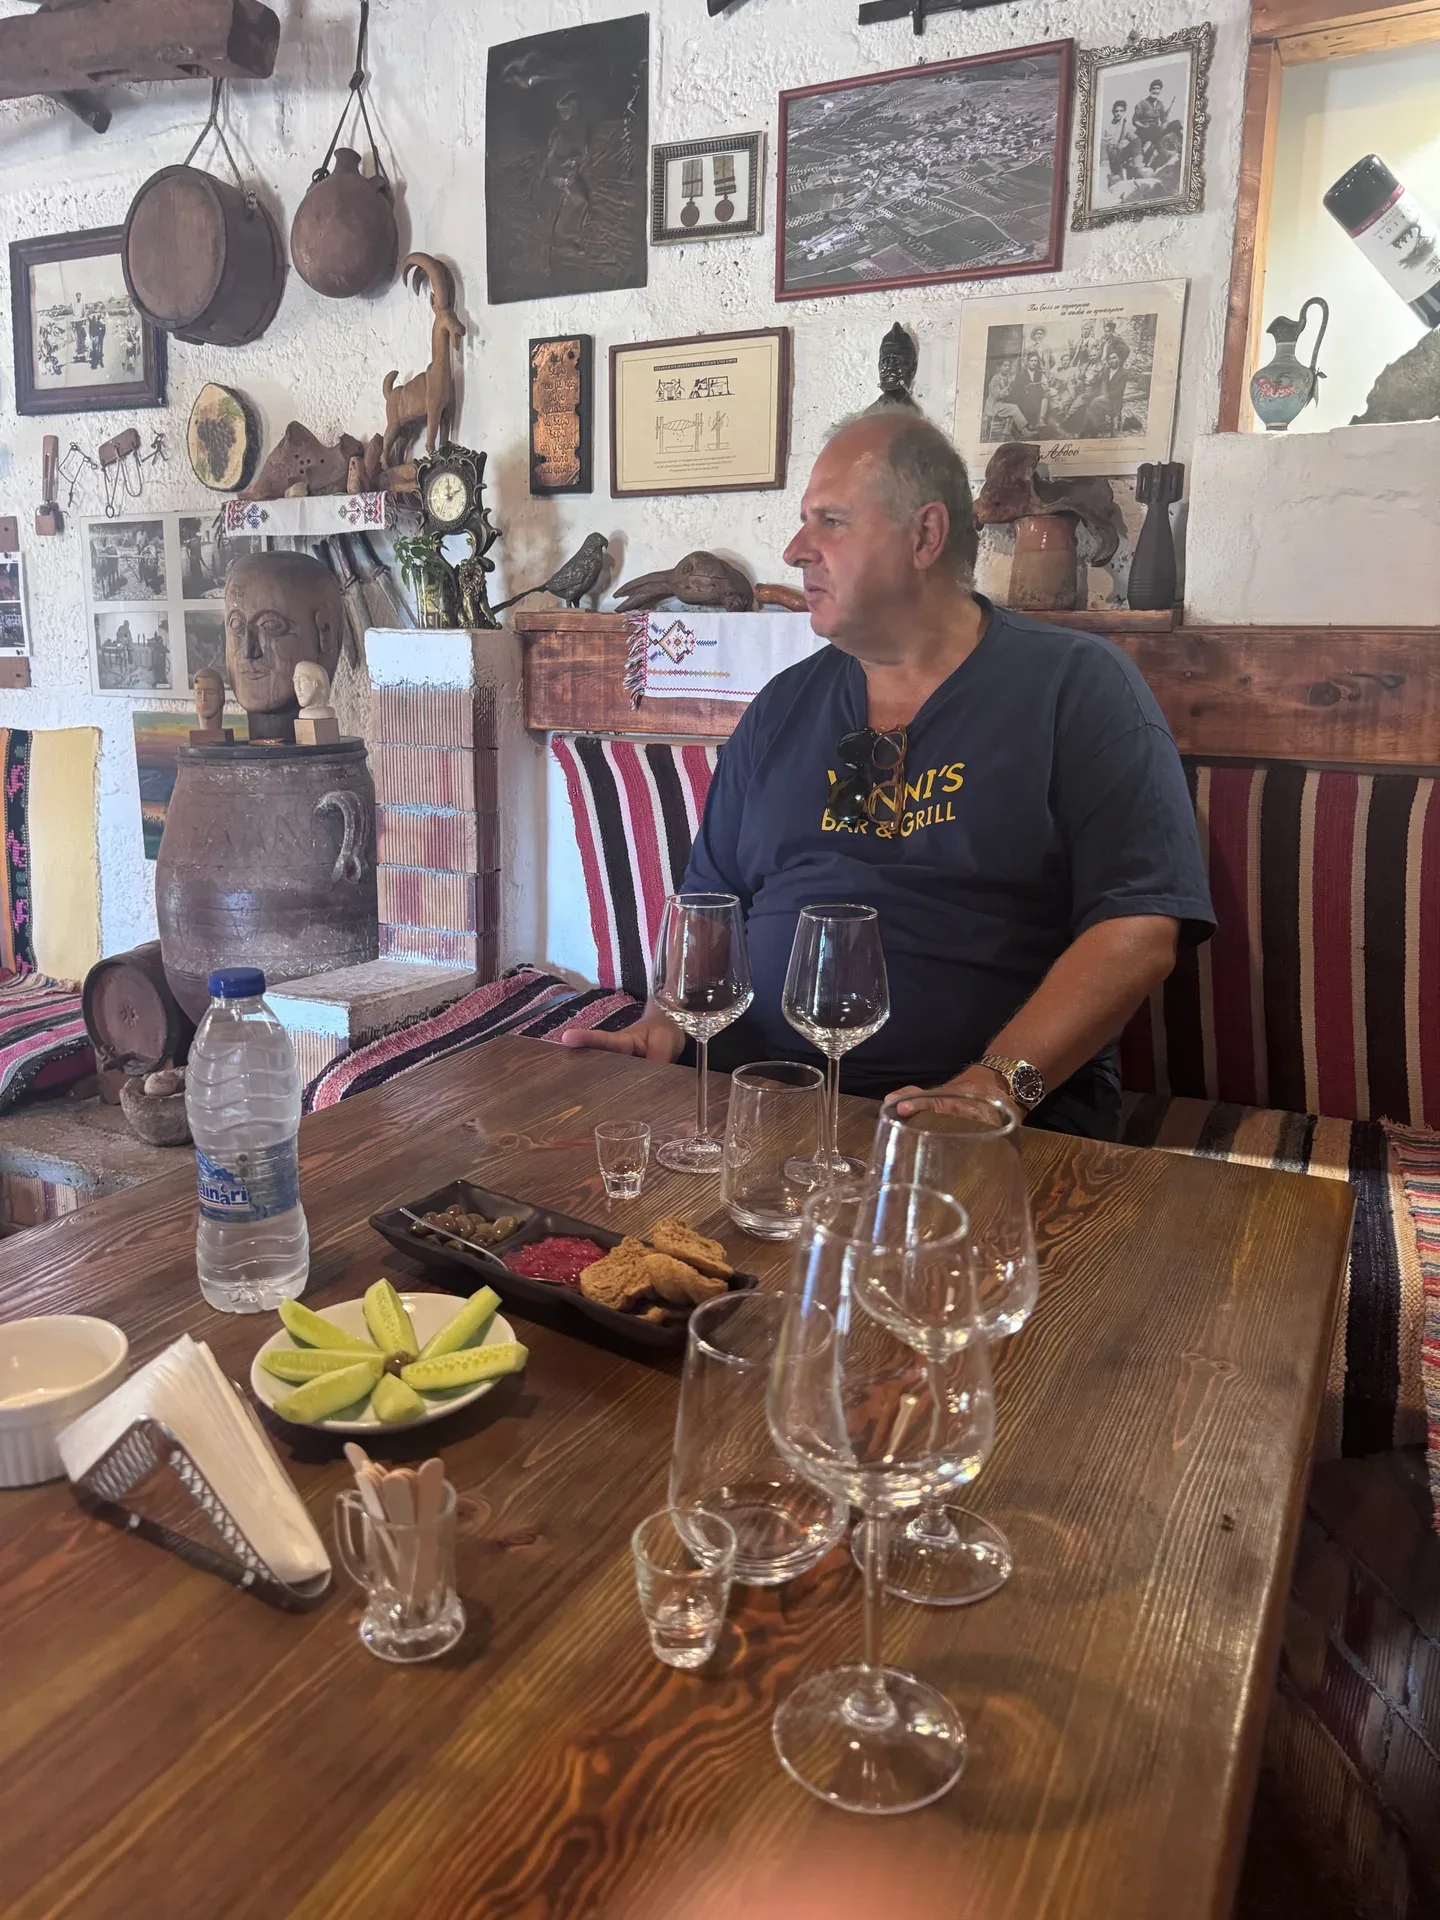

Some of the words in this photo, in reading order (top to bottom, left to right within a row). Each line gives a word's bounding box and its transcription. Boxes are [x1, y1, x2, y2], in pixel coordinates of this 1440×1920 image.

[827, 762, 966, 816] YNNI'S
[821, 808, 870, 835] BAR
[875, 822, 895, 840] &
[900, 801, 957, 838] GRILL
